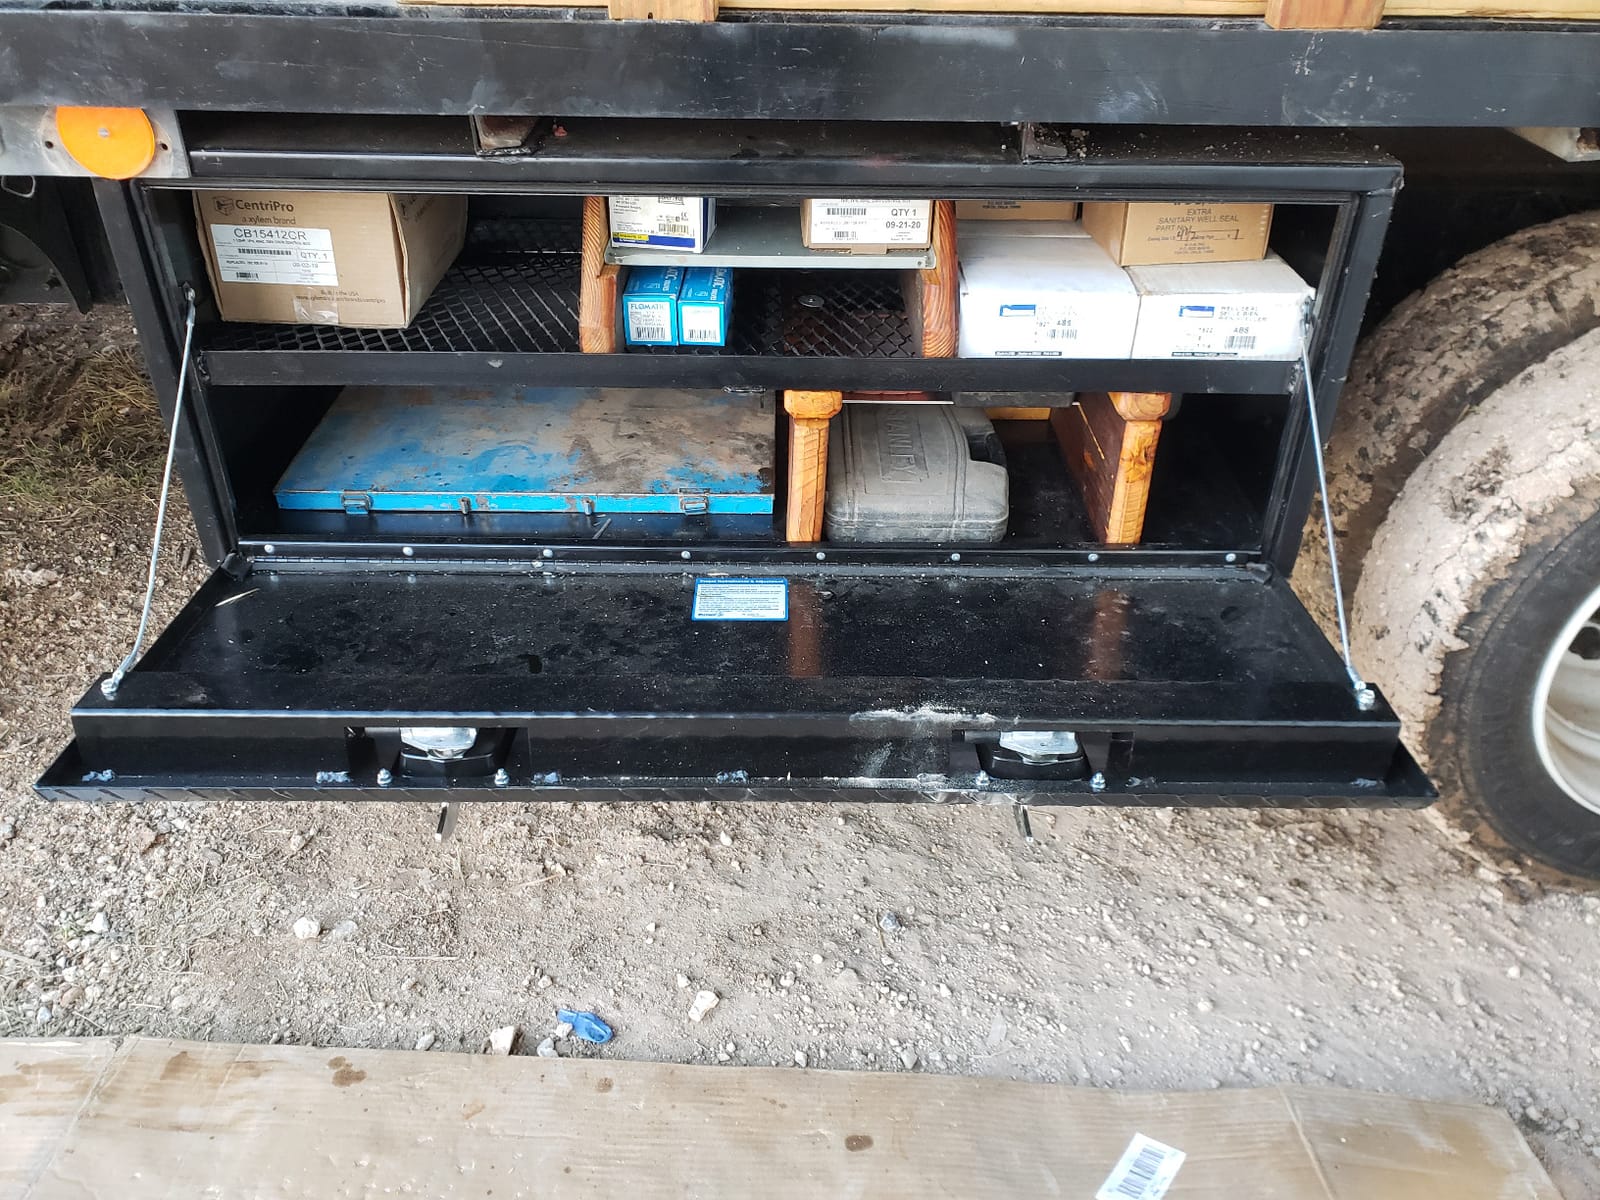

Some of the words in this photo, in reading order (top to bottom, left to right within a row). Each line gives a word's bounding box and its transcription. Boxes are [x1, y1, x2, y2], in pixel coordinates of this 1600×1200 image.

[235, 199, 294, 212] CentriPro
[891, 208, 910, 217] QTY
[1187, 208, 1212, 216] EXTRA
[249, 216, 273, 224] xylem
[274, 216, 297, 225] brand
[1158, 216, 1196, 225] SANITARY
[1197, 215, 1218, 223] WELL
[1220, 214, 1240, 222] SEAL
[885, 220, 922, 229] 09-21-20
[233, 227, 308, 241] CB15412CR
[1233, 326, 1250, 334] ABS
